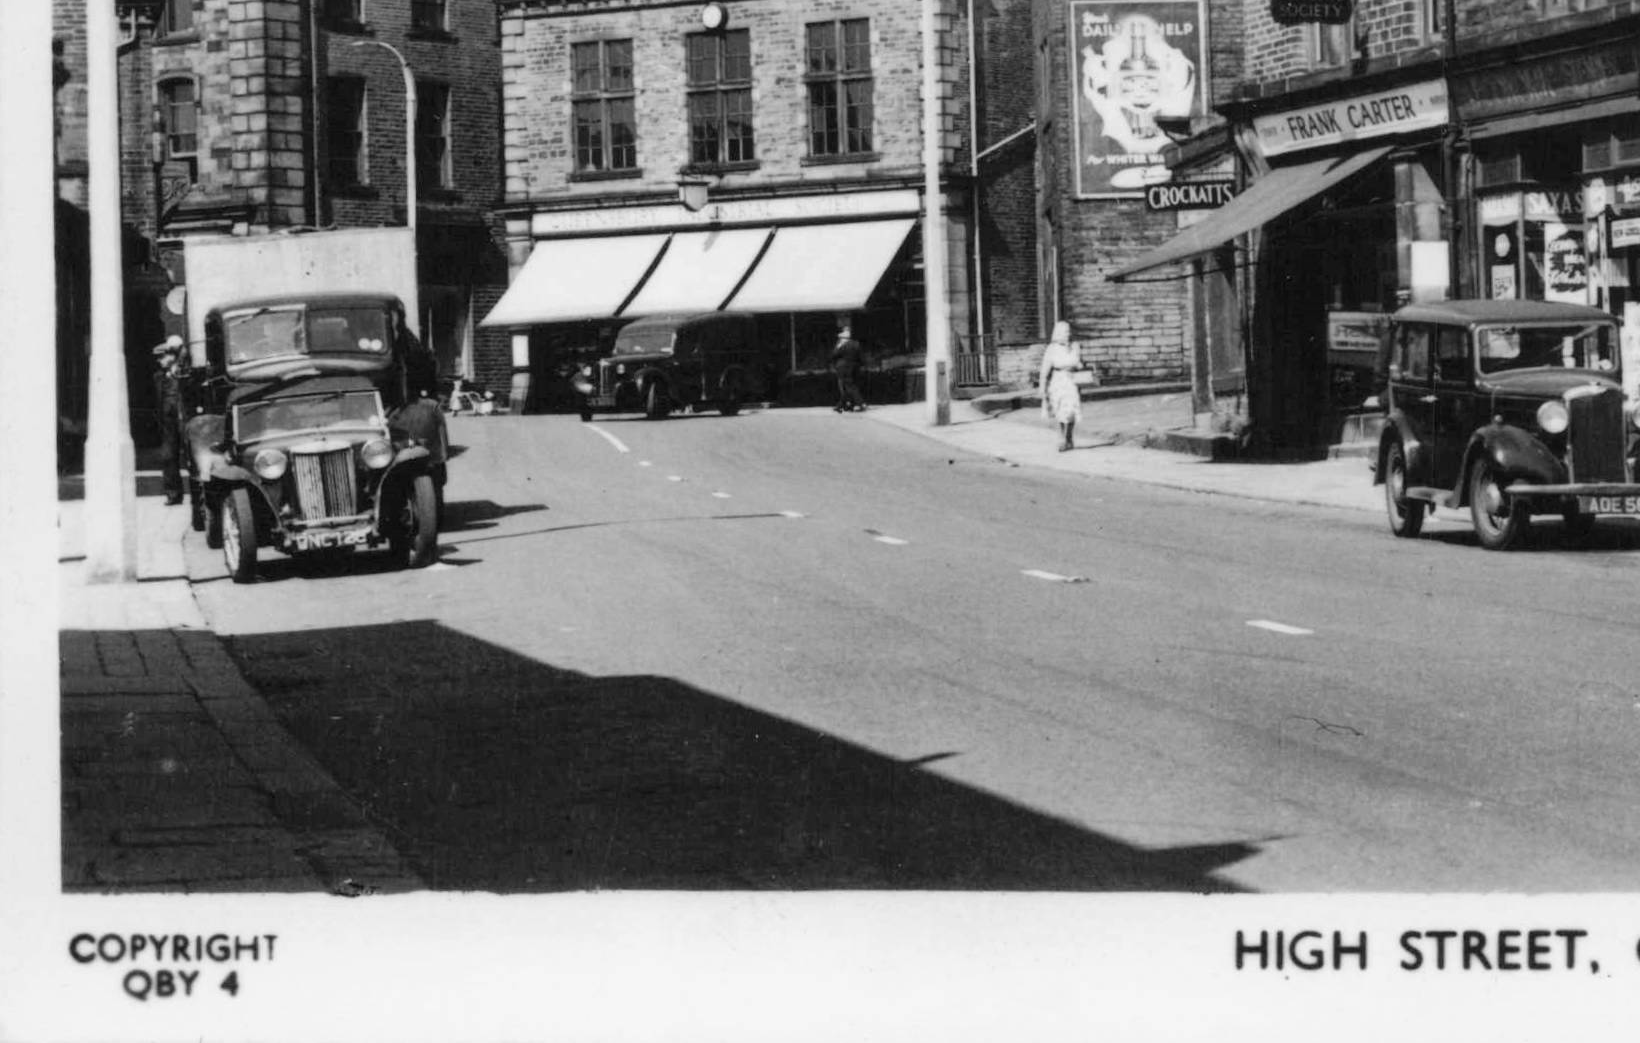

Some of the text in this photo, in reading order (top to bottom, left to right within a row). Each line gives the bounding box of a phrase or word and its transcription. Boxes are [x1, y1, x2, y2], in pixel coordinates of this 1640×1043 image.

[1279, 3, 1341, 17] SOCIETY
[1286, 109, 1342, 141] FRANK
[1347, 94, 1417, 129] CARTER
[1106, 153, 1146, 165] WHITER
[1148, 182, 1233, 209] CROCKATTS
